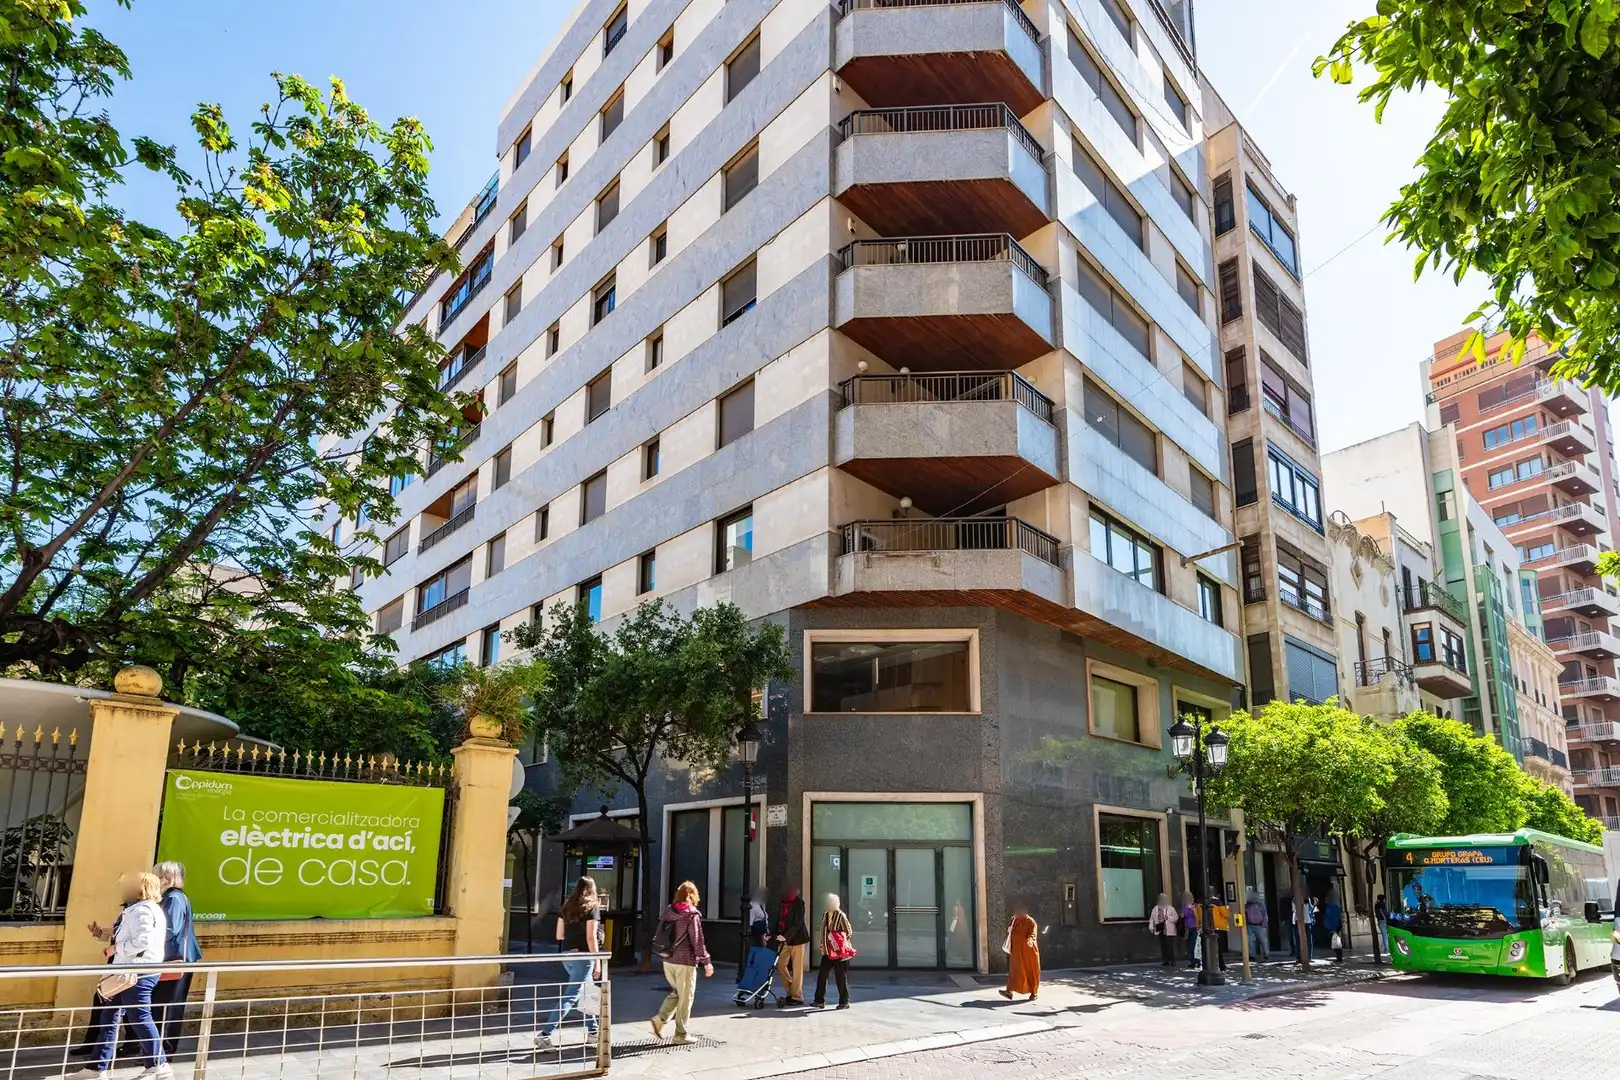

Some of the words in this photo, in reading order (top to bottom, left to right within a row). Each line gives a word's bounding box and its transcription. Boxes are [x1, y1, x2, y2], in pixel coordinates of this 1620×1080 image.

[176, 774, 233, 790] Oppidum
[223, 805, 246, 822] La
[252, 808, 420, 829] comercialitzadora
[220, 823, 343, 849] elèctrica
[348, 829, 416, 854] d'ací,
[218, 848, 283, 886] de
[298, 859, 412, 886] casa.
[1406, 852, 1413, 864] 4
